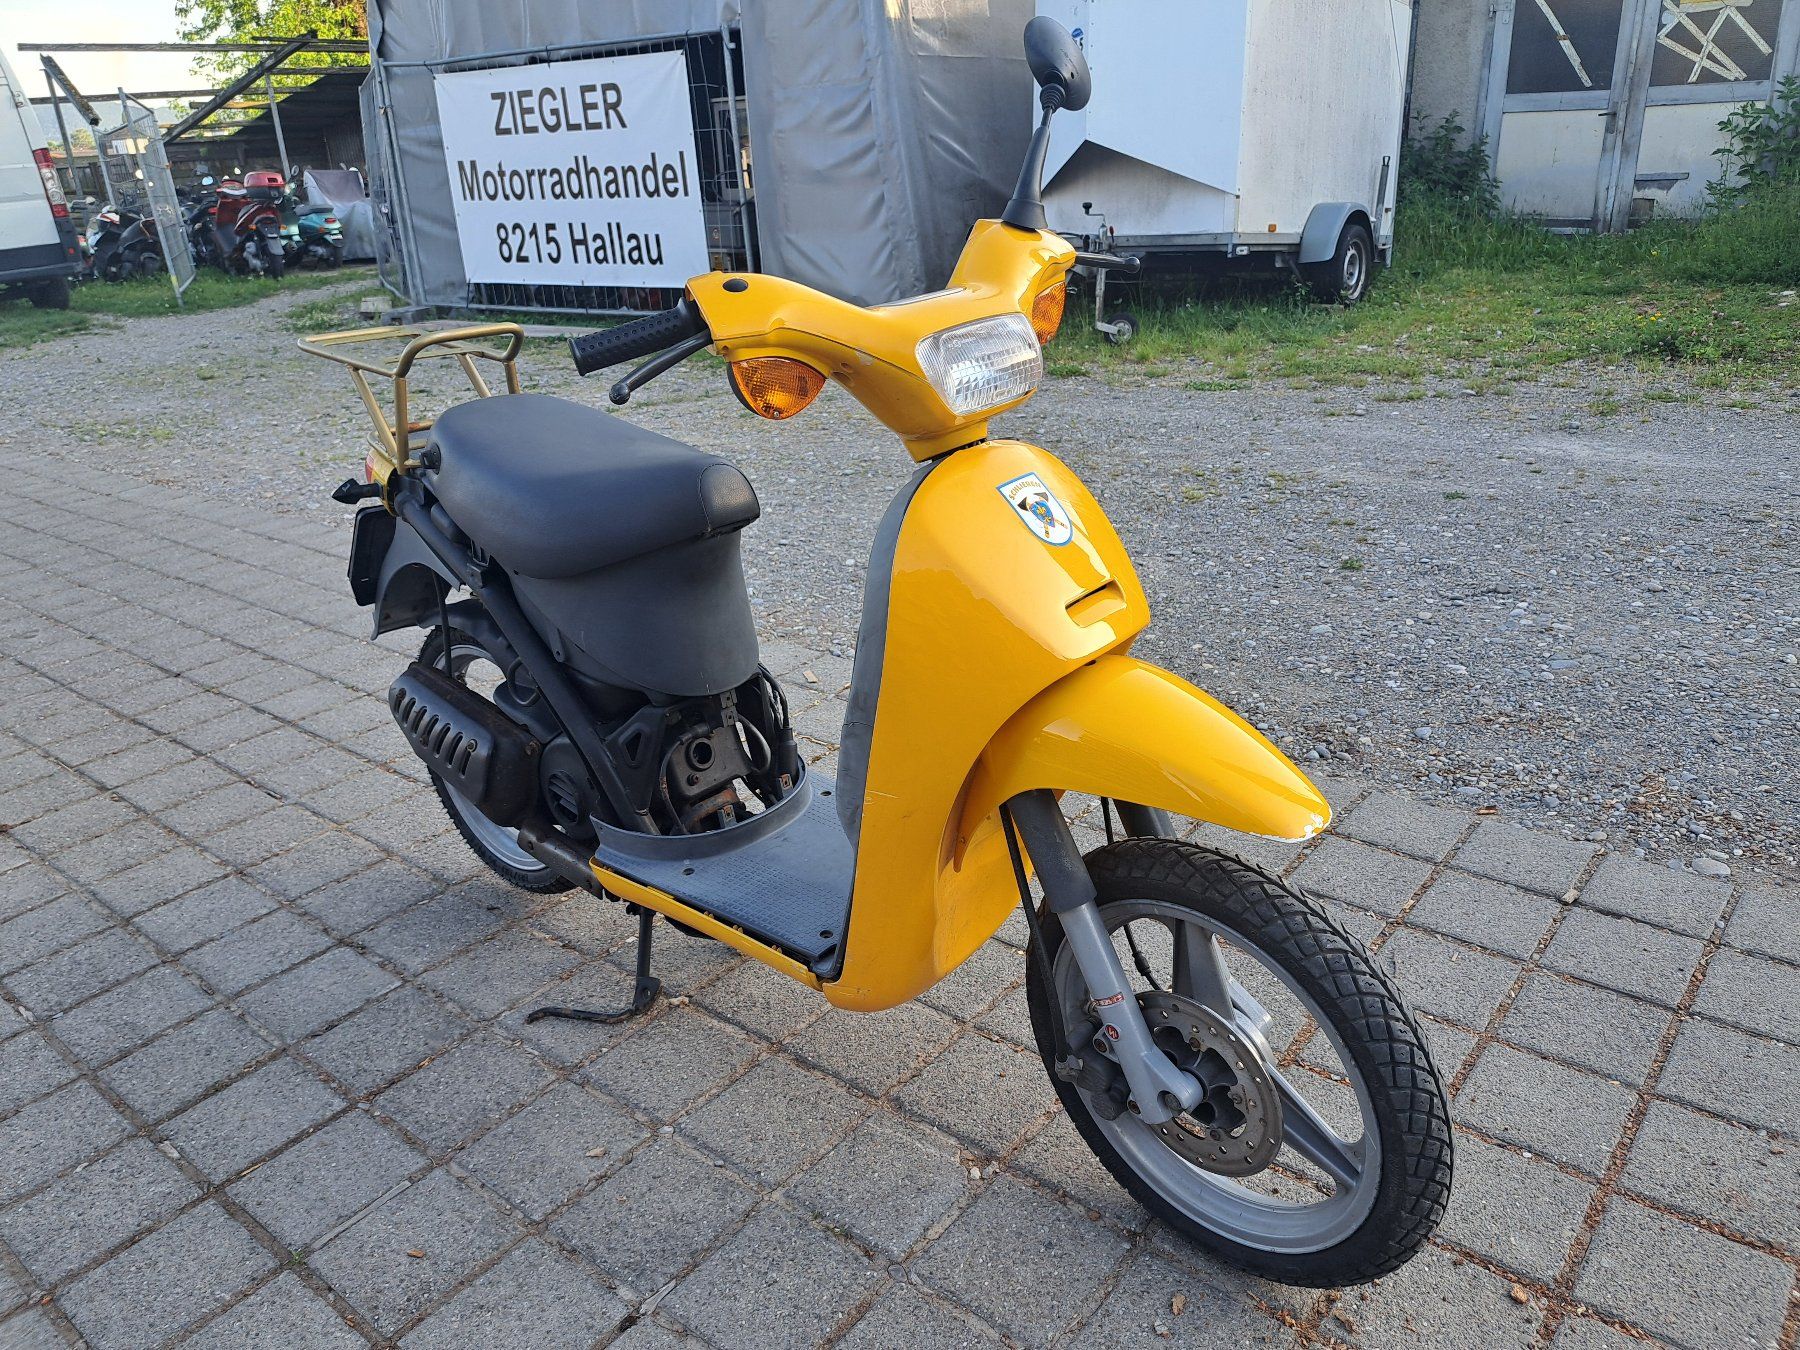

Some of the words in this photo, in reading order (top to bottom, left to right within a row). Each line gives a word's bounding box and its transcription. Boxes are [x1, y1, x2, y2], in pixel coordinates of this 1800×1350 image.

[490, 82, 628, 136] ZIEGLER
[457, 151, 690, 202] Motorradhandel
[496, 222, 562, 264] 8215
[568, 221, 664, 266] Hallau
